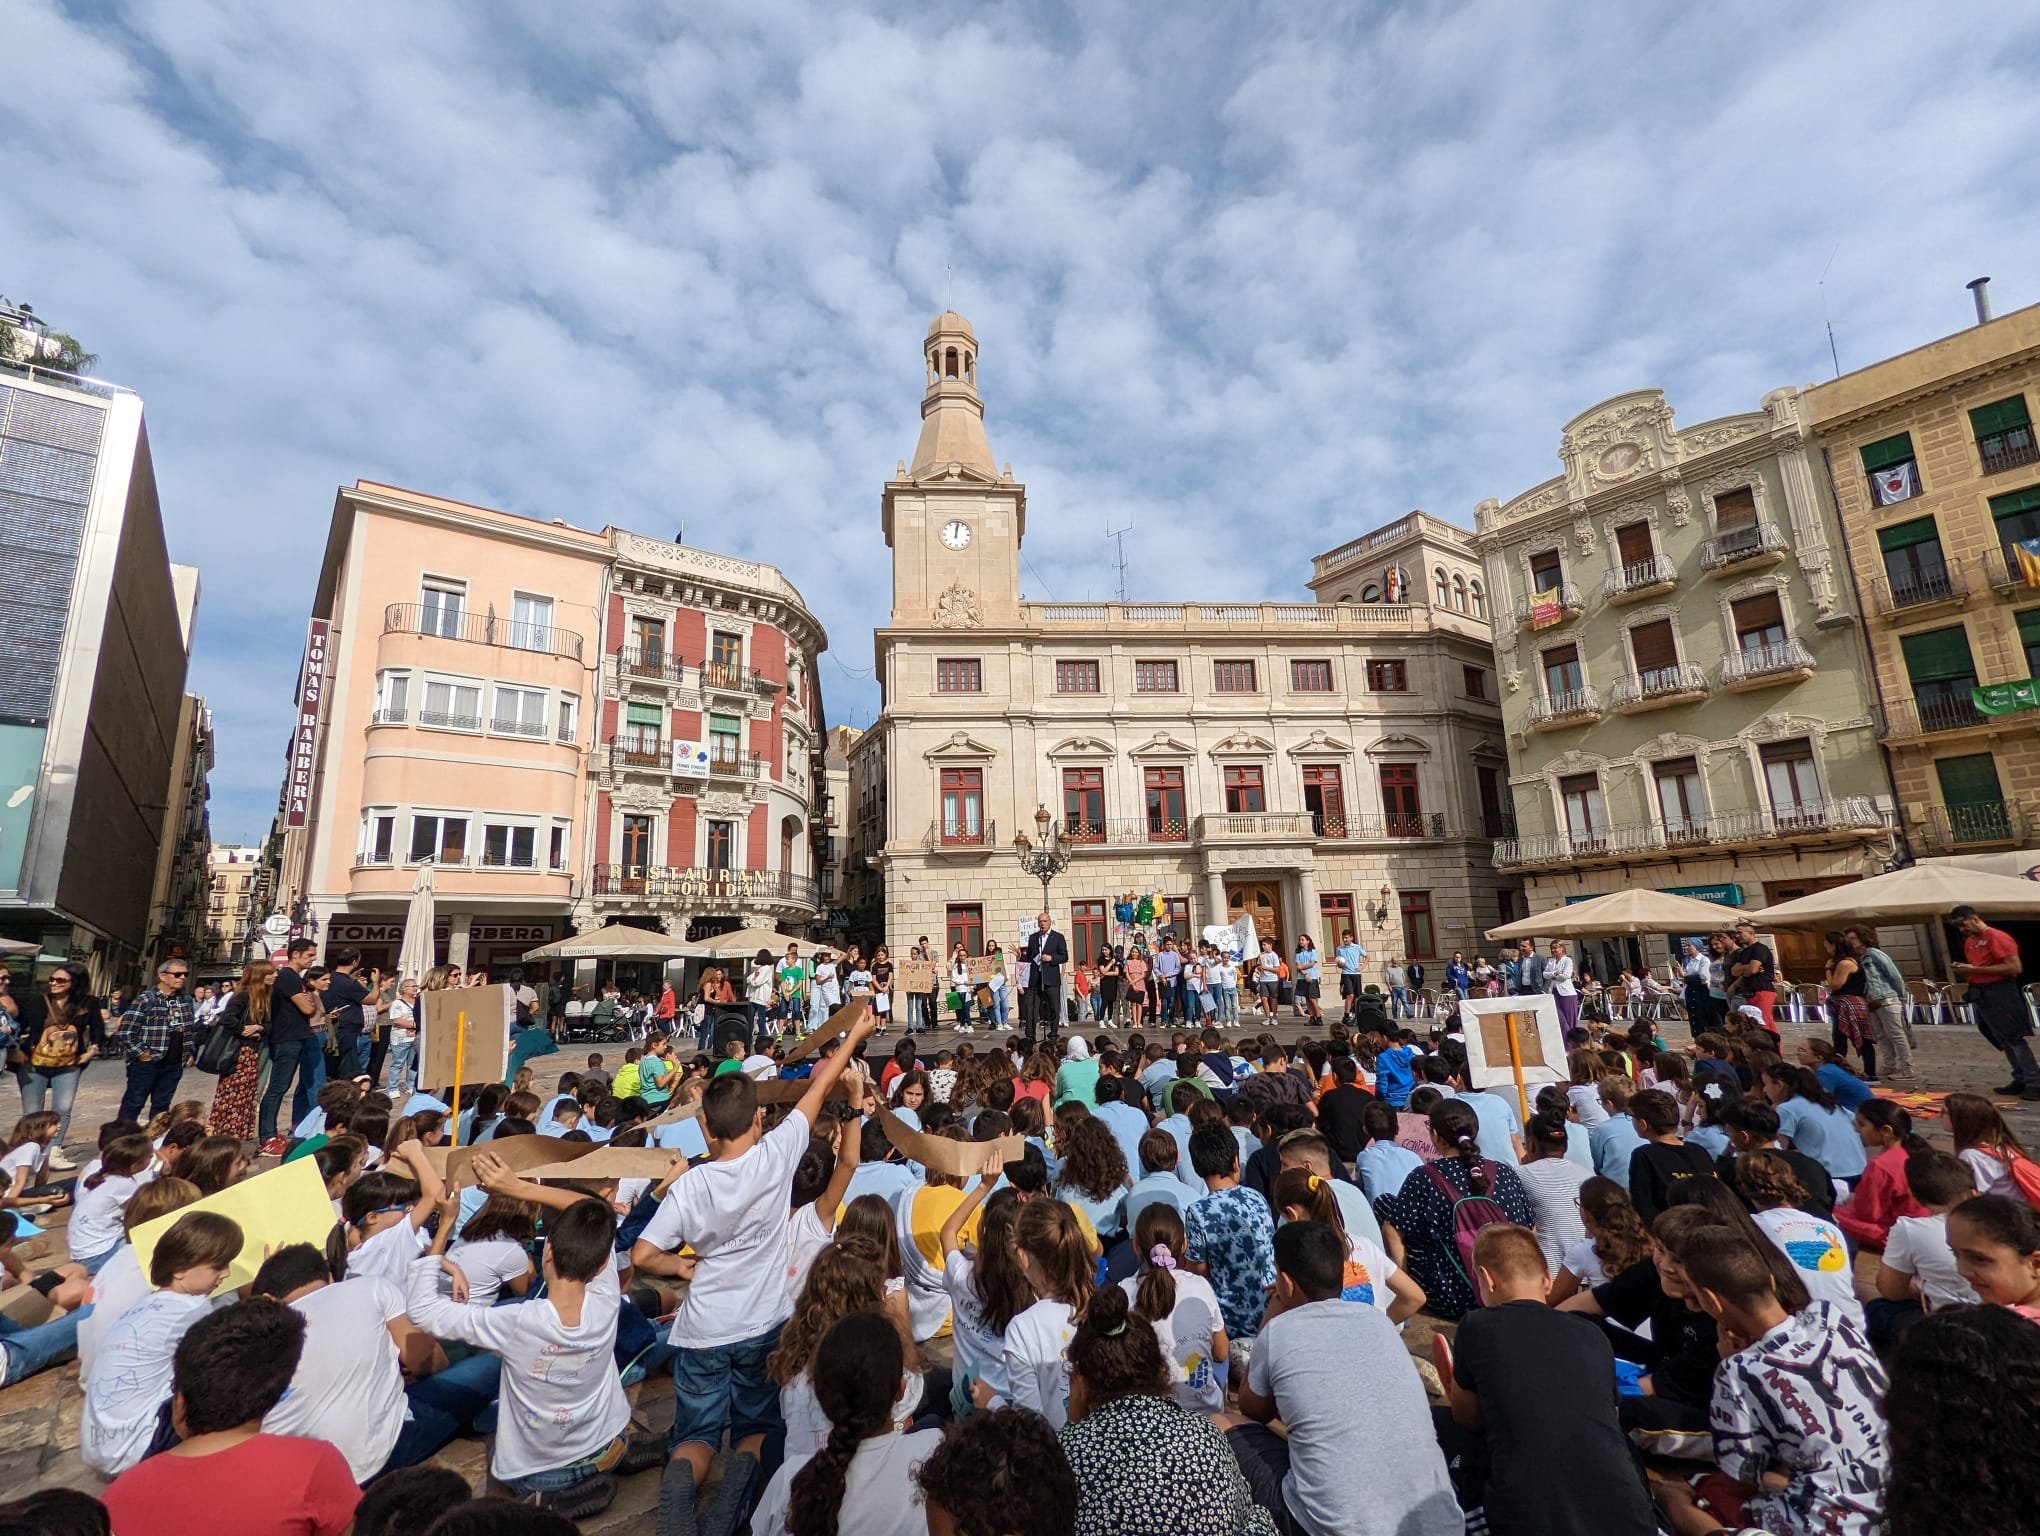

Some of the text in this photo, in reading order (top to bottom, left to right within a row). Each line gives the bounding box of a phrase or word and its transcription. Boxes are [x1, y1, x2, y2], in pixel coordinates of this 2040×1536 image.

[610, 864, 781, 883] RESTAURANT
[645, 881, 753, 897] FLORIDA
[436, 927, 545, 940] BRBERA
